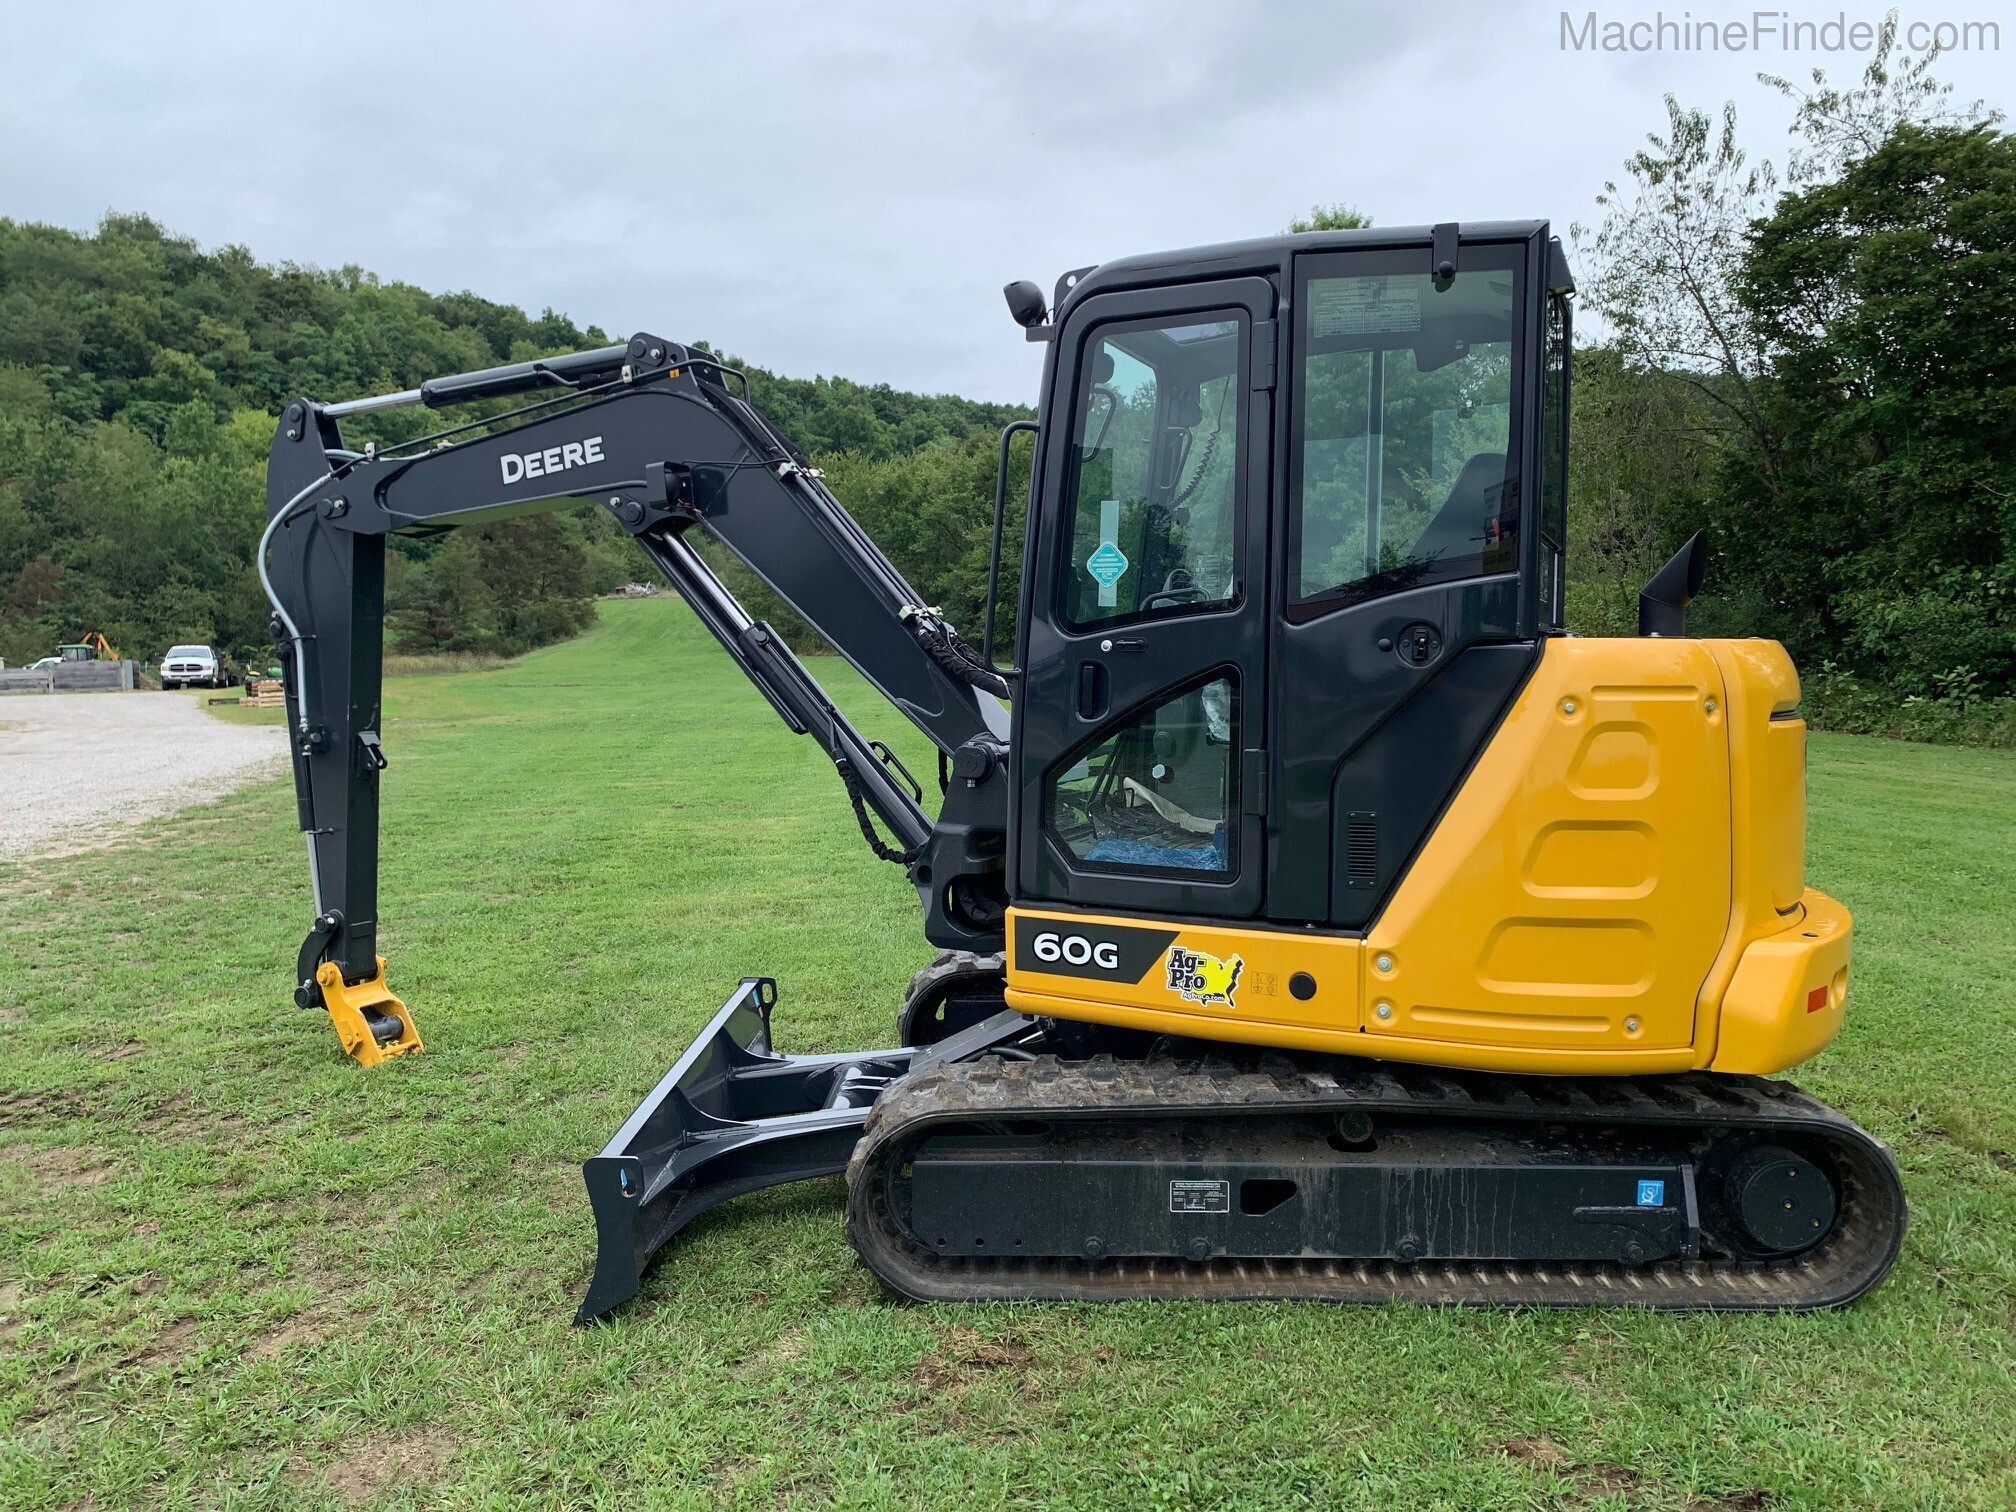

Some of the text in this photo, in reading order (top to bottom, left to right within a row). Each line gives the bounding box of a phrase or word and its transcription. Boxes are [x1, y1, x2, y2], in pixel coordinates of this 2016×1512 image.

[500, 436, 605, 485] DEERE
[1033, 932, 1119, 970] 60G
[1169, 968, 1207, 991] Pro
